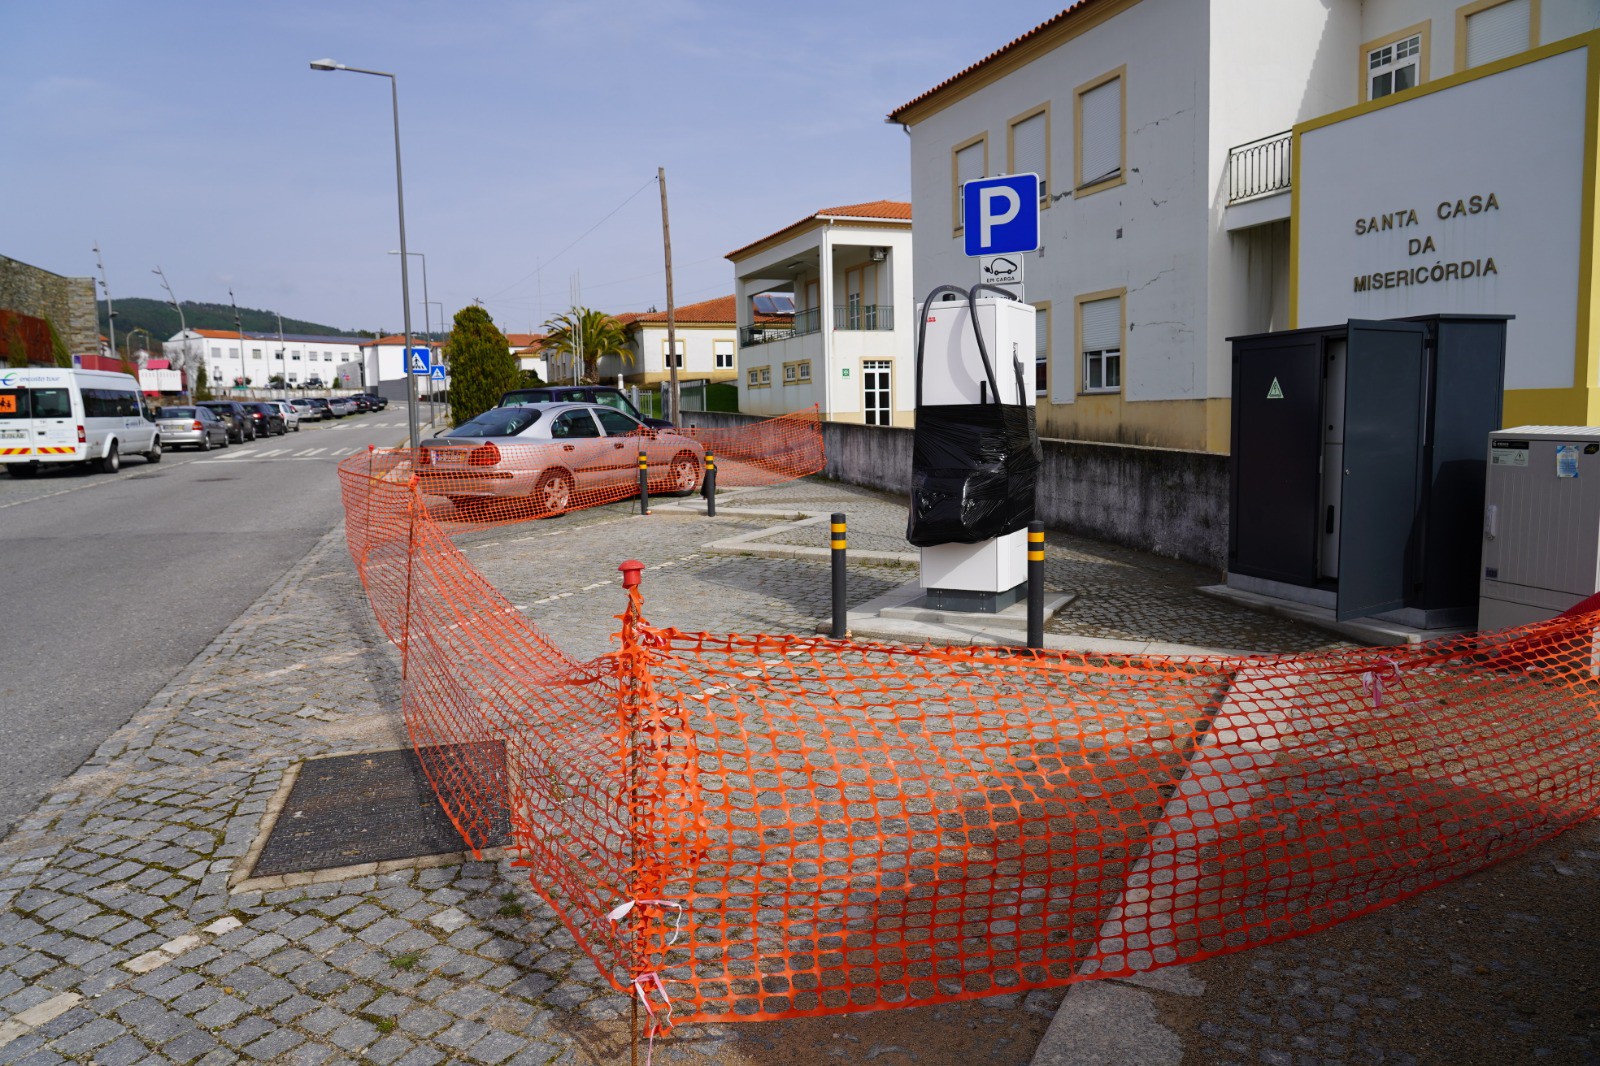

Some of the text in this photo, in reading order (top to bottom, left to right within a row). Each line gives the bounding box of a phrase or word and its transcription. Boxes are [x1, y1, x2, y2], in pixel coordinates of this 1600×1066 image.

[979, 185, 1021, 248] P
[1355, 192, 1500, 236] SANTA CASA
[1408, 235, 1436, 256] DA
[1353, 257, 1498, 293] MISERICÓRDIA
